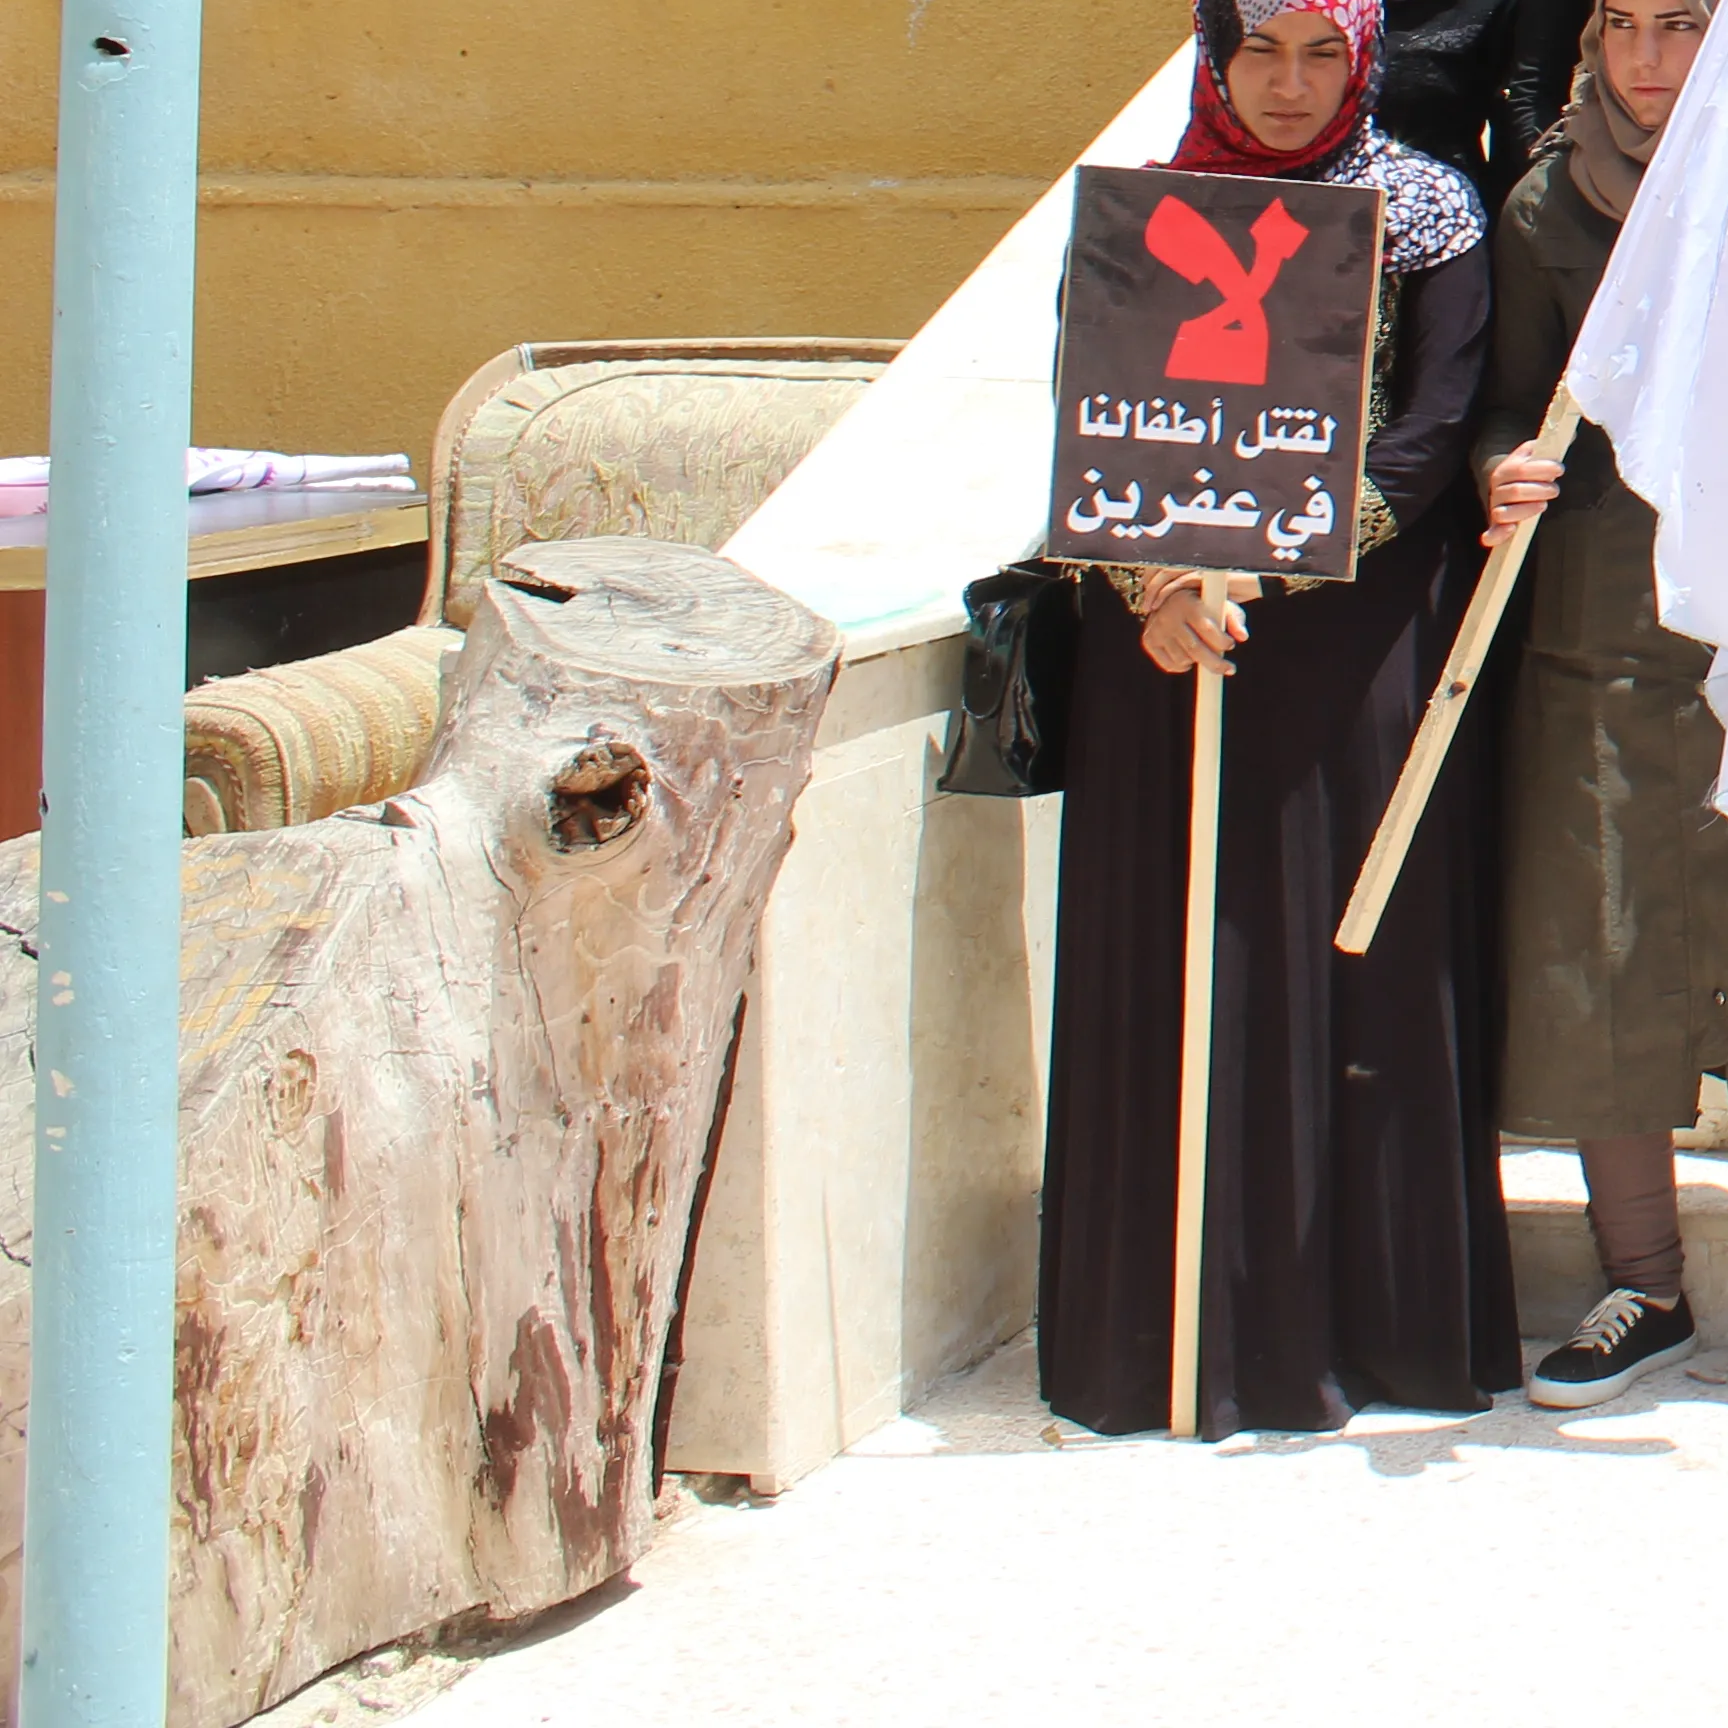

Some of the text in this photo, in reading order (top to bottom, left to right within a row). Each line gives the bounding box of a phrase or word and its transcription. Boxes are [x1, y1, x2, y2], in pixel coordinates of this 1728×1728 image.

[1144, 193, 1311, 386] لا
[1077, 393, 1338, 459] لقتل أطفالنا
[1066, 467, 1336, 562] في عفرين
